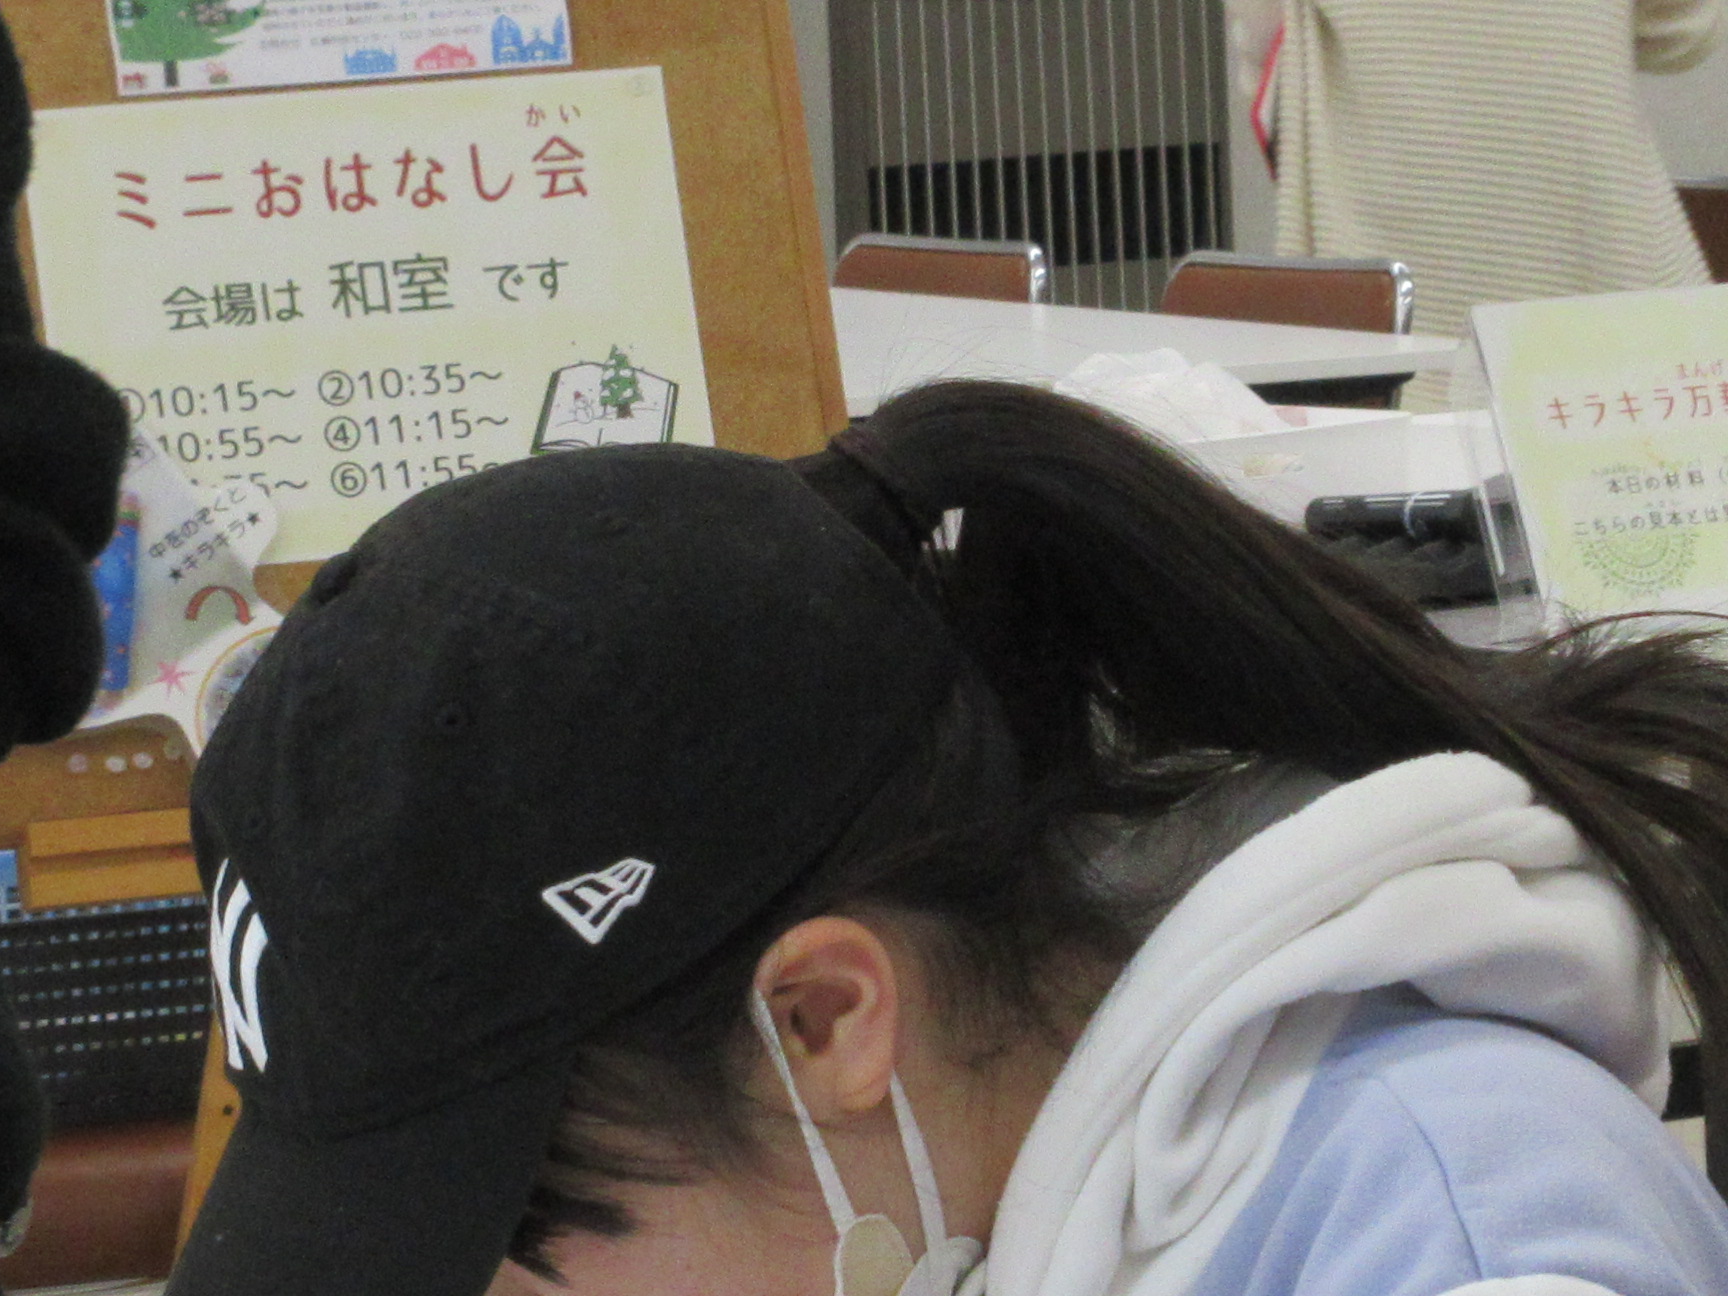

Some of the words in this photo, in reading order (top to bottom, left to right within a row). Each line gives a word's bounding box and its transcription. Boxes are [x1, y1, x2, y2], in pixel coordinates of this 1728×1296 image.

[526, 102, 582, 128] かい
[114, 134, 590, 229] ミニおはなし会
[328, 253, 454, 318] 和室
[483, 257, 570, 302] です
